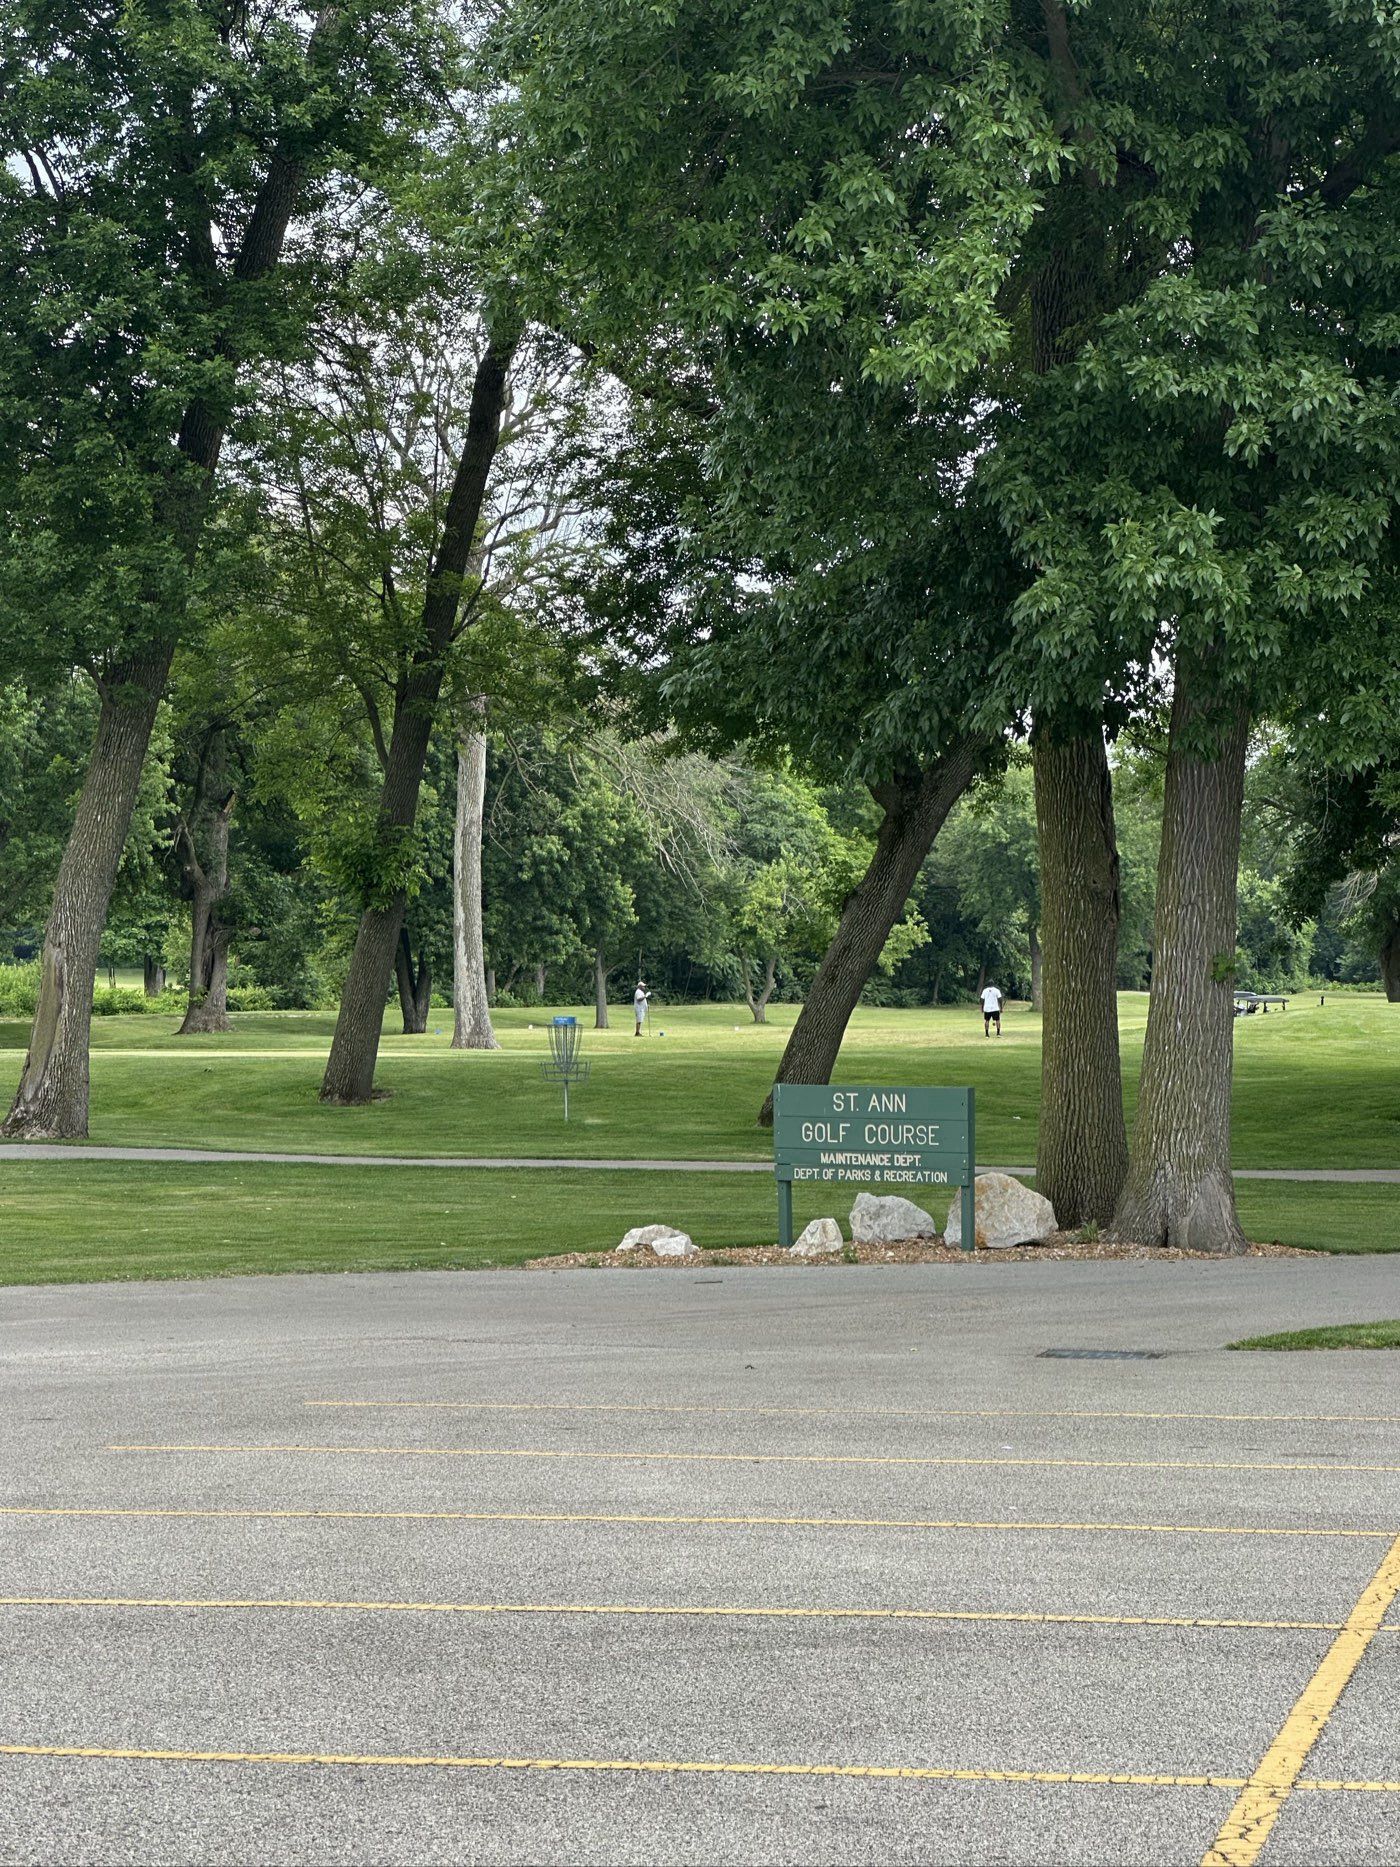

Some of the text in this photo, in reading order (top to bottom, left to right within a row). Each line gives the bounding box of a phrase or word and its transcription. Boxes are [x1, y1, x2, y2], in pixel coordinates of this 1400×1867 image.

[833, 1093, 906, 1113] ST. ANN
[801, 1122, 940, 1146] GOLF COURSE
[820, 1152, 922, 1167] MAINTENANCE DEPT.
[794, 1168, 948, 1183] DEPT. OF PARKS & RECREATION
